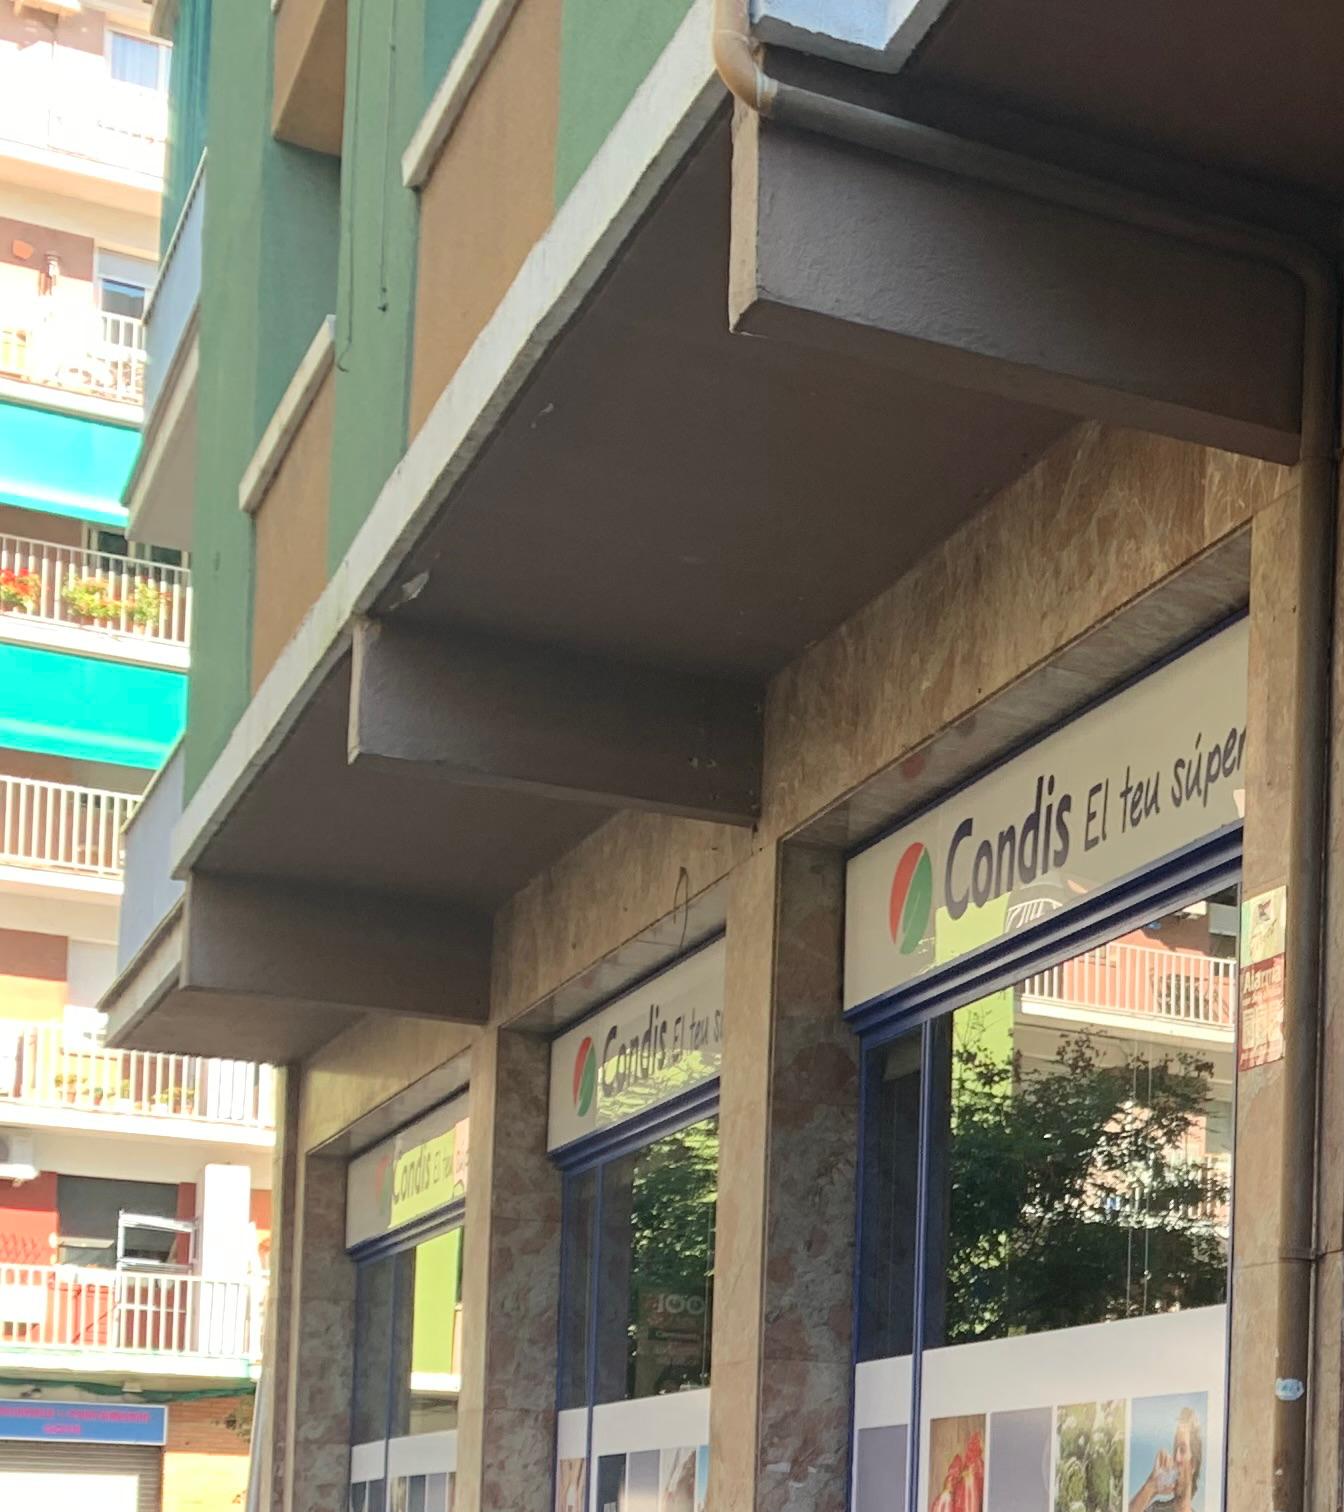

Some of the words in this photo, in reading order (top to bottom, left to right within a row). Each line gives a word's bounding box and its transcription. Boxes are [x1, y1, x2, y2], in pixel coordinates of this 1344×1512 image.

[944, 774, 1072, 920] Condis
[1084, 777, 1109, 852] El
[1119, 765, 1160, 833] teu
[602, 1004, 667, 1097] Condis
